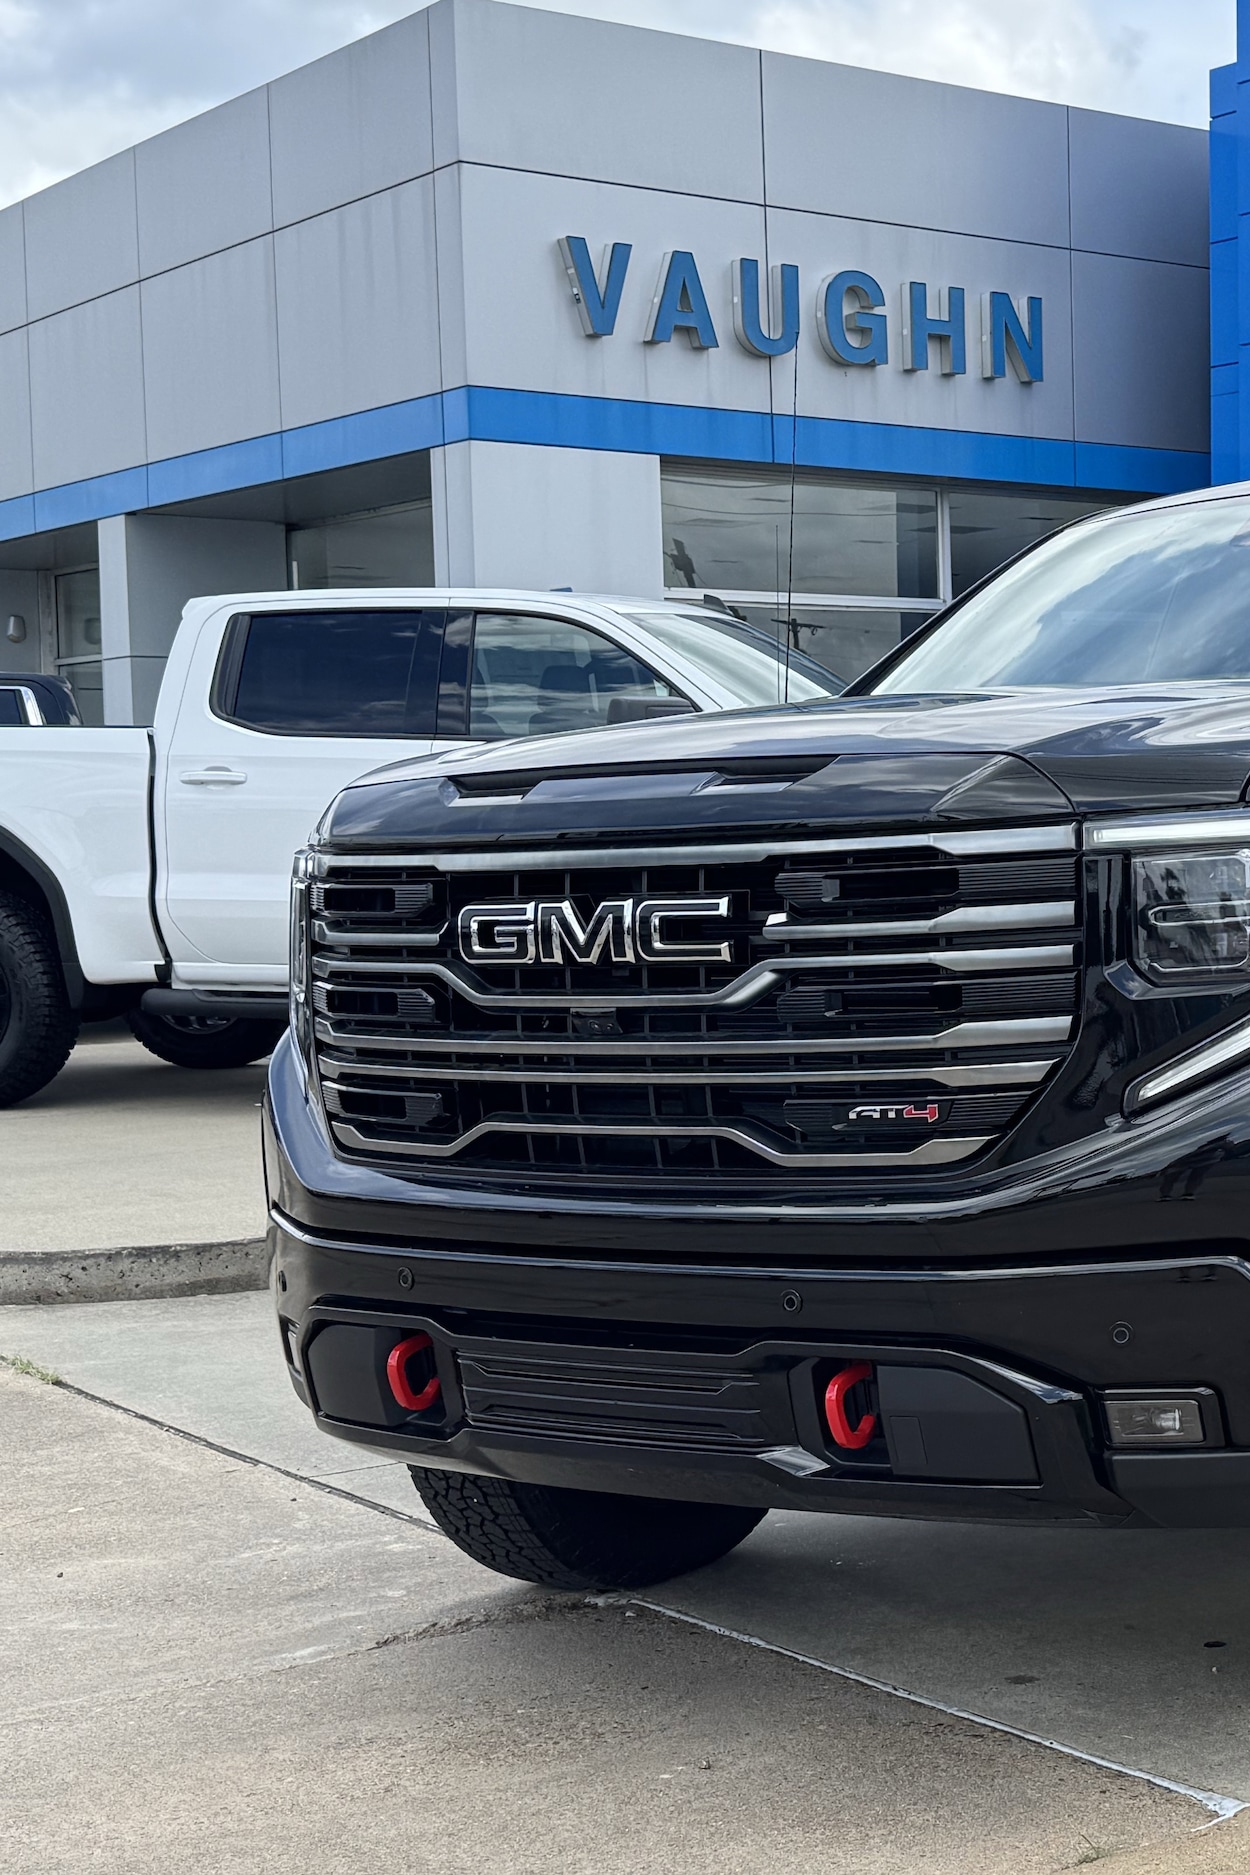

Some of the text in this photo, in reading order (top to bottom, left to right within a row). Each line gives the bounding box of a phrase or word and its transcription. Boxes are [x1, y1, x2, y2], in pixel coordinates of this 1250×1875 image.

[558, 235, 1044, 383] VAUGHN
[457, 897, 733, 966] GMC
[848, 1103, 939, 1123] AT4
